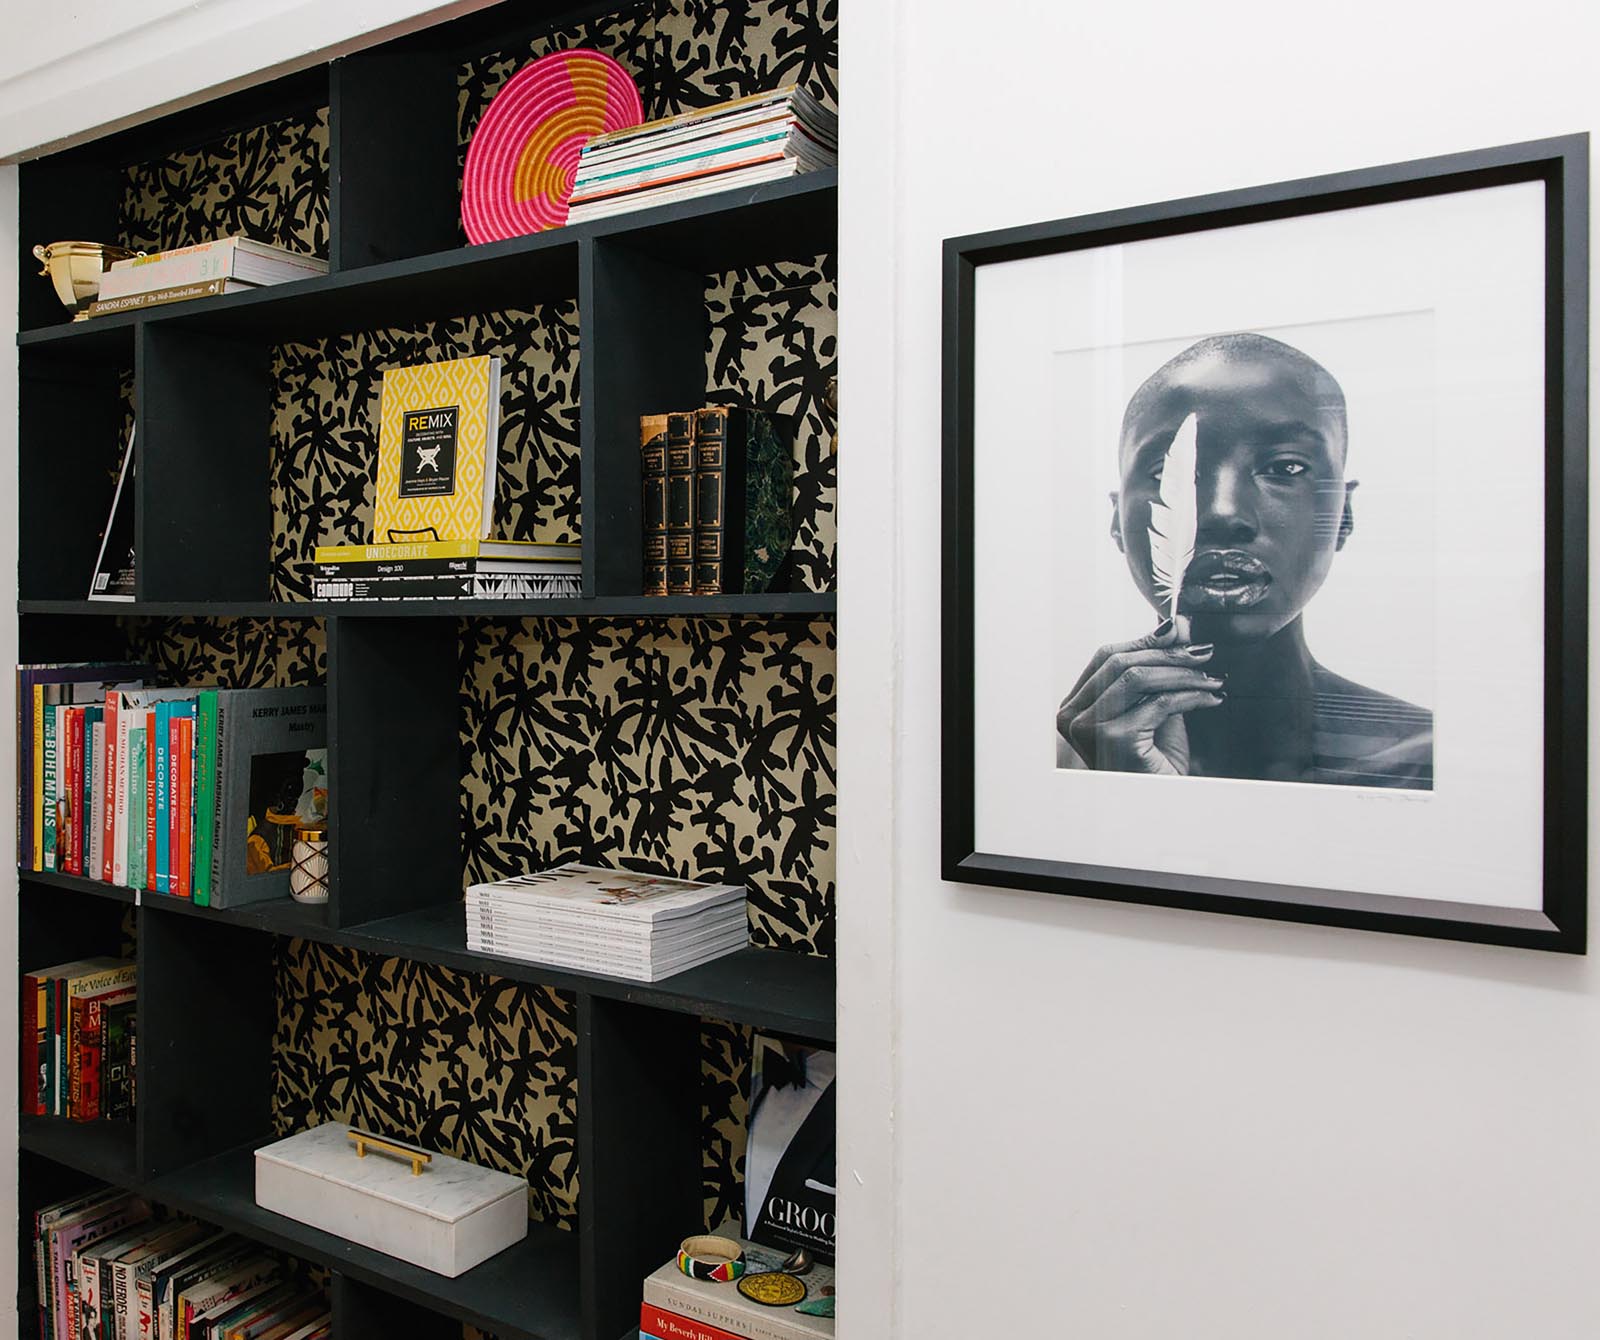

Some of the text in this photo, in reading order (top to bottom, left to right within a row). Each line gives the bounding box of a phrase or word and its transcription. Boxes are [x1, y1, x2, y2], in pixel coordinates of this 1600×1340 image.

[95, 298, 120, 312] SANDRA
[120, 295, 145, 308] ESPINET
[408, 412, 453, 431] REMIX
[366, 545, 429, 559] UNDECORATE
[217, 708, 225, 737] KERRY
[252, 706, 279, 718] KERRY
[280, 704, 307, 716] JAMES
[289, 720, 314, 733] Mastry
[216, 737, 224, 768] JAMES
[131, 747, 139, 794] domino
[157, 747, 165, 810] DECORATE
[45, 740, 56, 828] BOHEMIANS
[147, 780, 155, 804] bite
[215, 769, 223, 819] MARSHALL
[147, 817, 155, 841] bite
[212, 820, 221, 850] Mastry
[72, 981, 87, 995] The
[89, 977, 110, 991] Voice
[111, 973, 121, 985] of
[72, 1010, 81, 1103] BLACK MASTERS
[115, 1265, 127, 1280] NO
[116, 1280, 128, 1316] HEROES
[667, 1297, 703, 1315] SUNDAY
[706, 1311, 748, 1330] SUPPERS
[656, 1316, 668, 1332] My
[668, 1321, 697, 1340] Beverly
